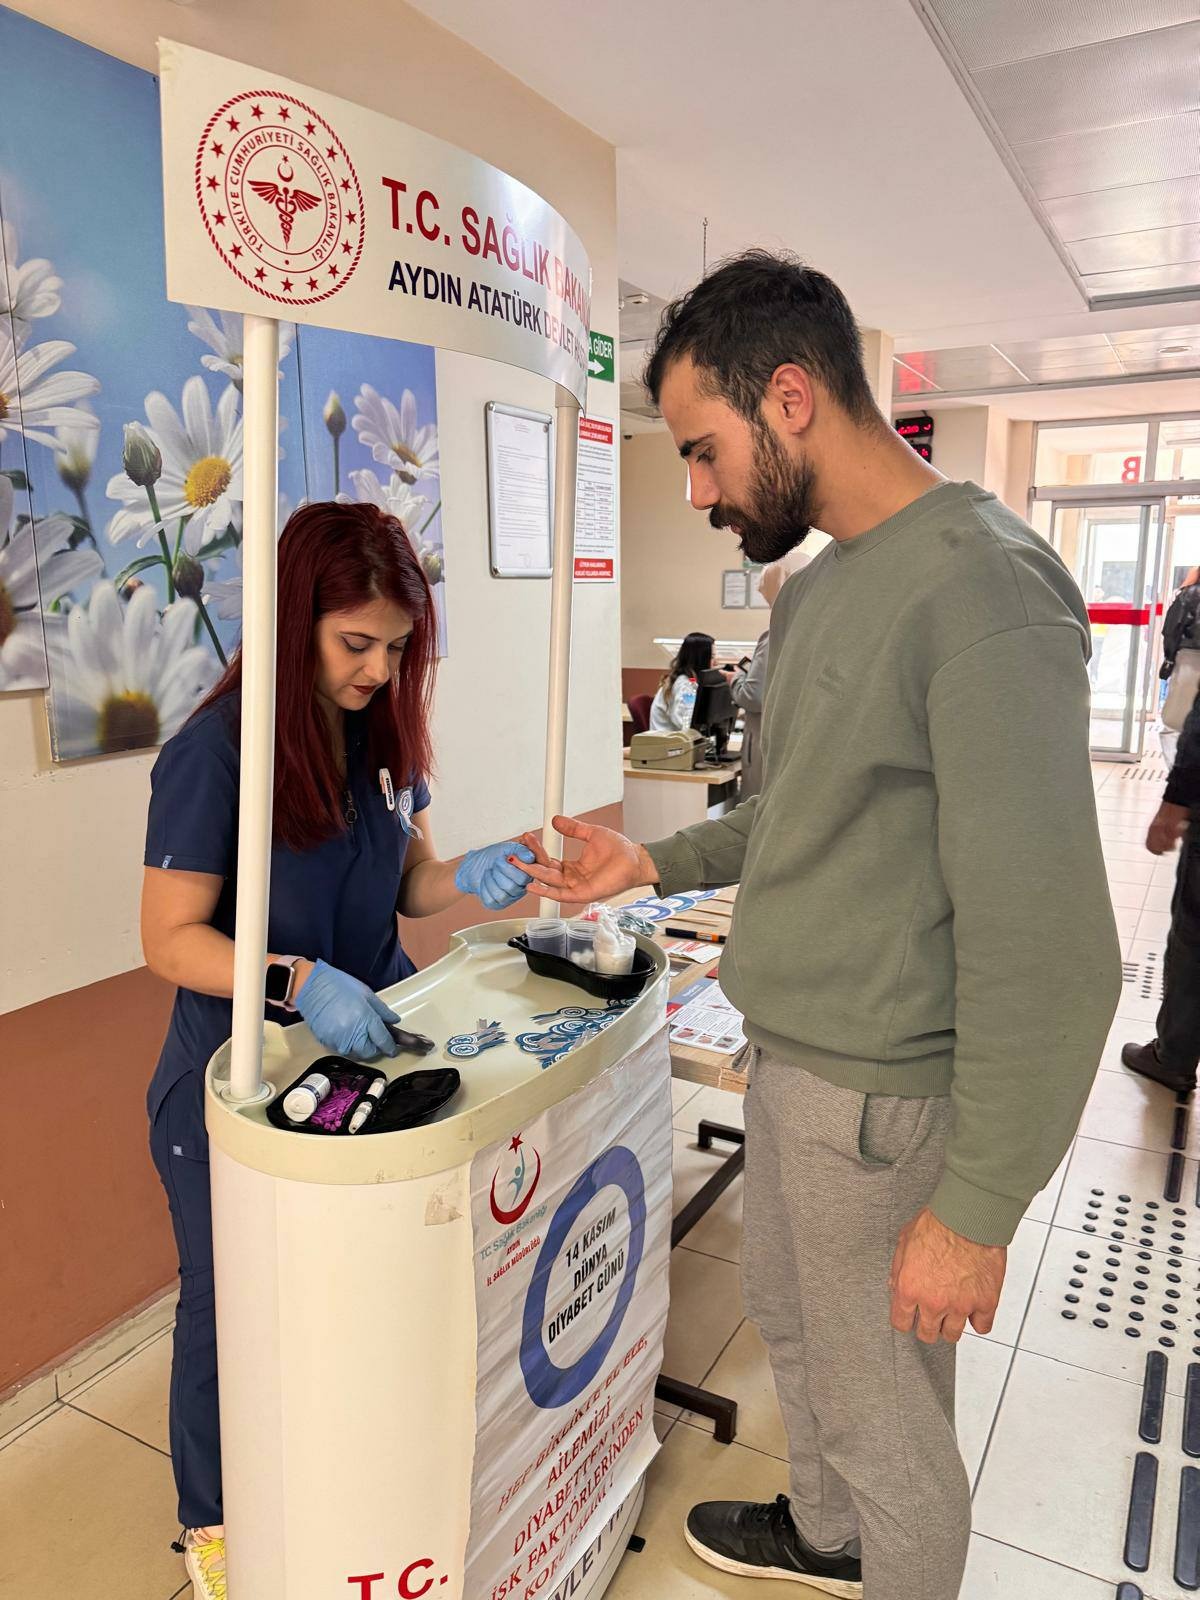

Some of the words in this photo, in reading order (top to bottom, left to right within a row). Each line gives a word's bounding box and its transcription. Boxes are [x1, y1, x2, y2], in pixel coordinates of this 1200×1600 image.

[230, 131, 294, 186] CUMHURİYETİ
[297, 142, 332, 188] SAĞLIK
[231, 191, 263, 253] TÜRKİYE
[311, 192, 338, 262] BAKANLIĞI
[382, 176, 451, 246] T.C.
[461, 206, 552, 291] SAĞLIK
[388, 260, 462, 307] AYDIN
[467, 281, 543, 336] ATATÜRK
[594, 336, 613, 360] GİDER
[566, 1241, 579, 1267] 14
[582, 1206, 617, 1253] KASIM
[574, 1243, 608, 1291] DÜNYA
[548, 1281, 595, 1344] DİYABET
[596, 1248, 624, 1294] GÜNÜ
[546, 1395, 611, 1490] AİLEMİZİ
[488, 1564, 522, 1600] İSK
[526, 1402, 643, 1574] FAKTÖRLERİNDEN
[513, 1429, 609, 1557] DİYABETTEN
